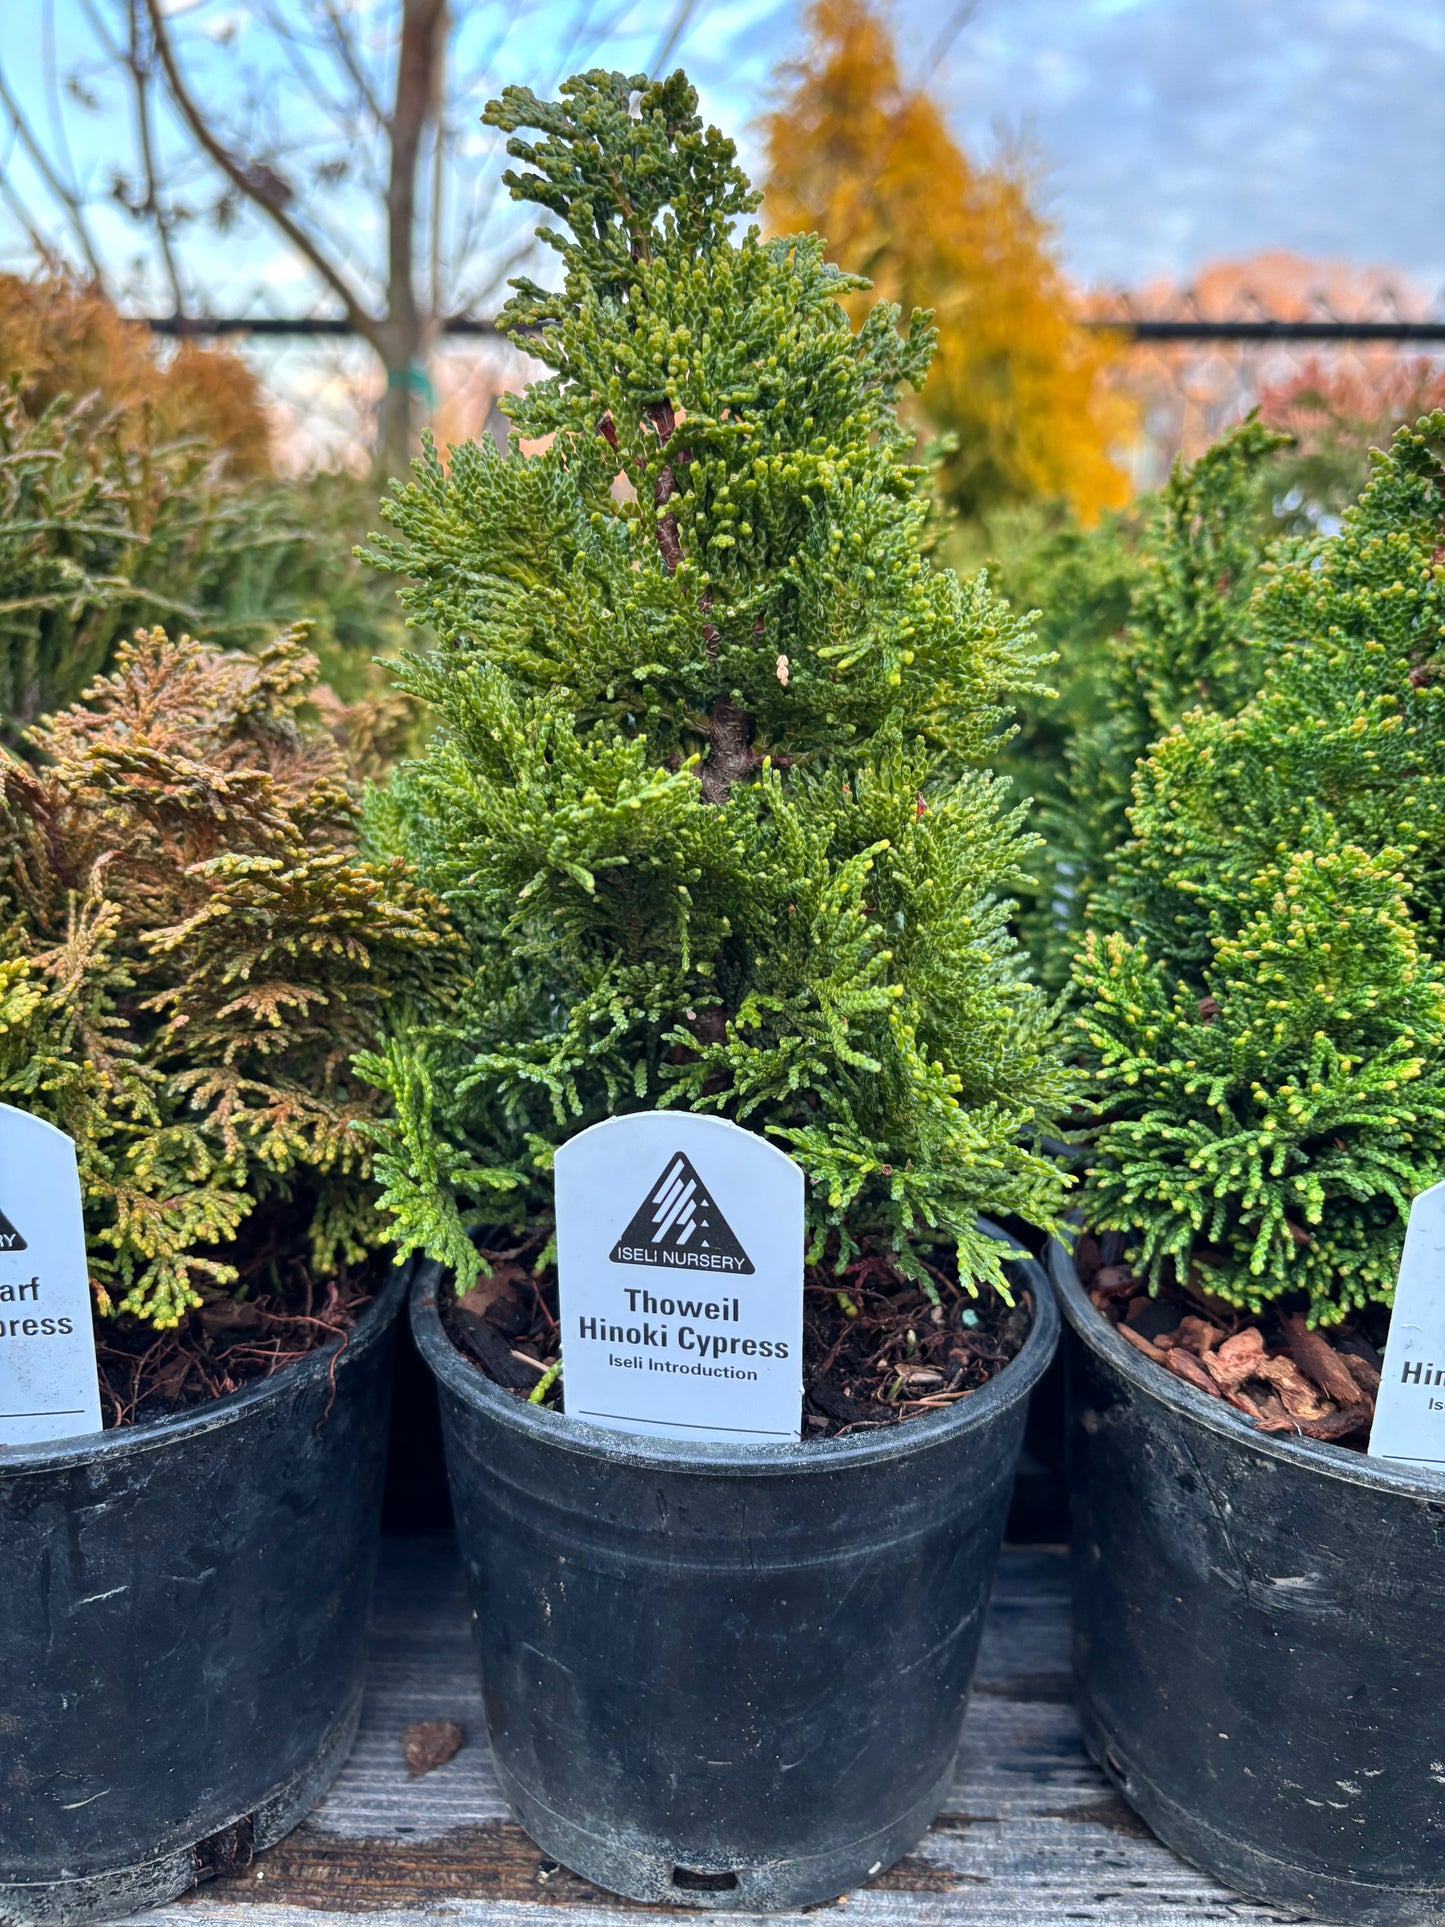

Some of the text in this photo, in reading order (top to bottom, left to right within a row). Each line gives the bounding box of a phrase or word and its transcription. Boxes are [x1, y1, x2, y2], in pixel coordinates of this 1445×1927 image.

[618, 1246, 746, 1271] ISELI NURSERY
[624, 1288, 740, 1322] Thoweil
[579, 1316, 789, 1359] Hinoki Cypress
[609, 1353, 758, 1381] Iseli Introduction
